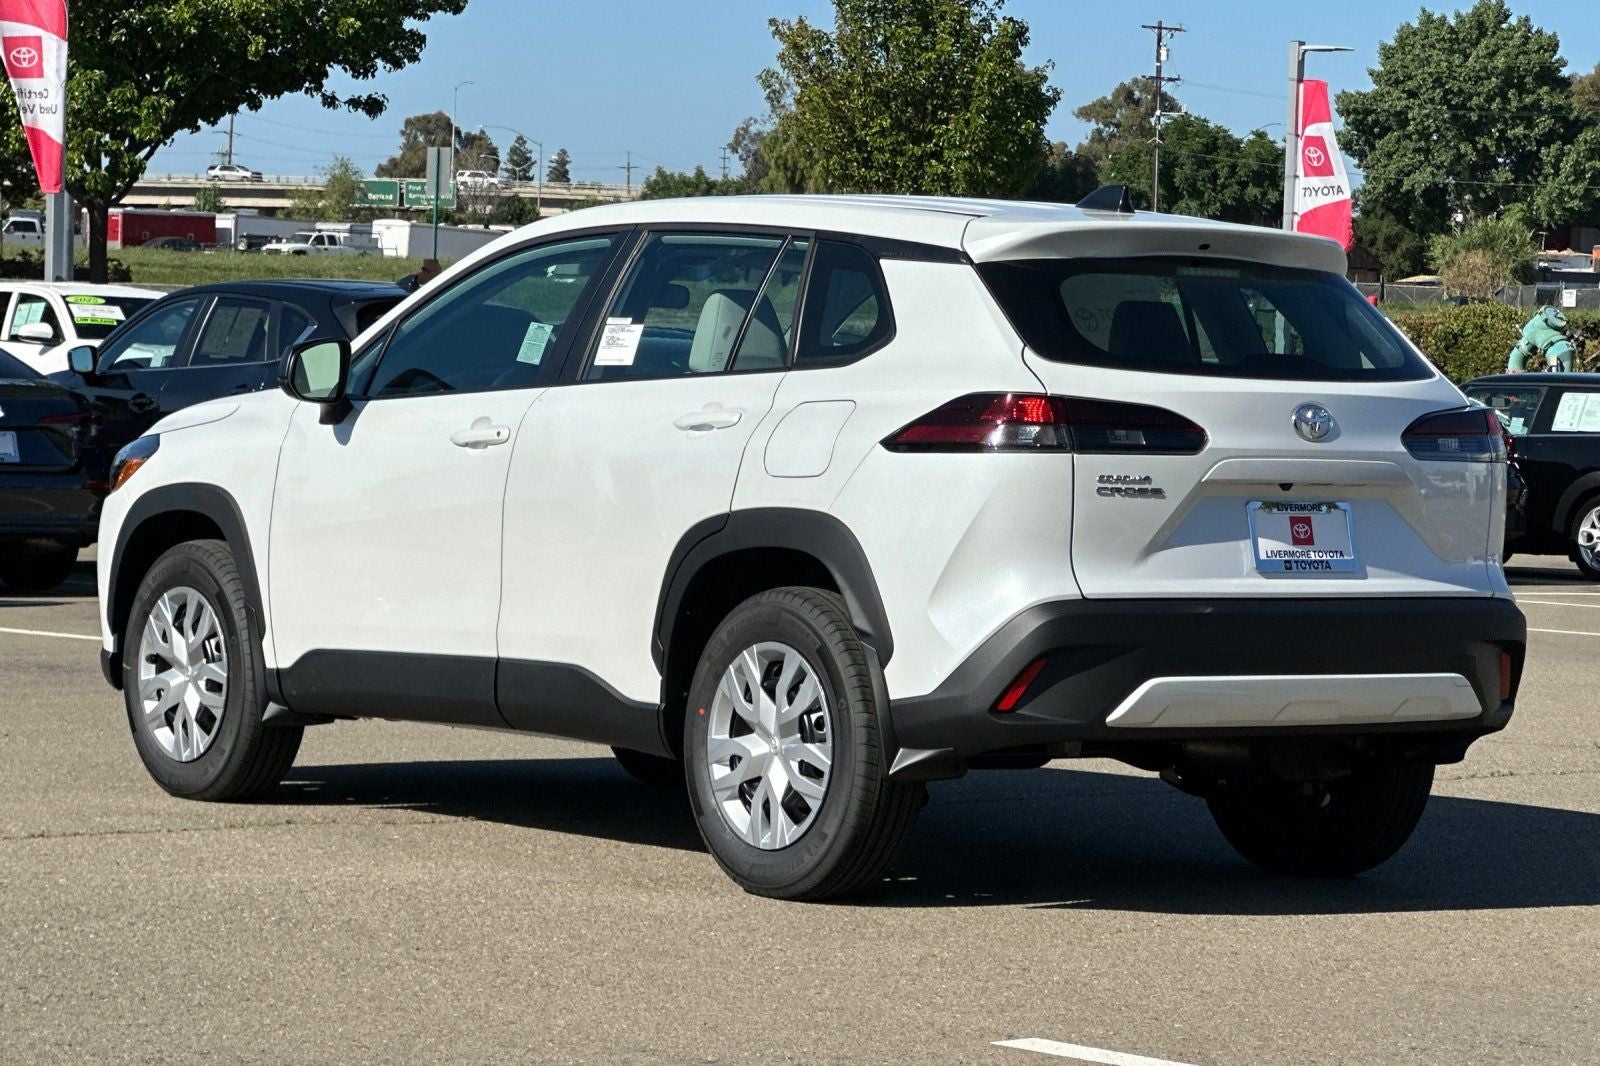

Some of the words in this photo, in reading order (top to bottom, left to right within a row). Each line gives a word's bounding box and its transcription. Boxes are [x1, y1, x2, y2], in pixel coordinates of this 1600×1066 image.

[1096, 486, 1166, 499] CROSS
[1277, 503, 1323, 512] LIVERMORE
[1265, 550, 1312, 559] LIVERMORE
[1313, 550, 1345, 559] TOYOTA
[1294, 560, 1333, 570] TOYOTA
